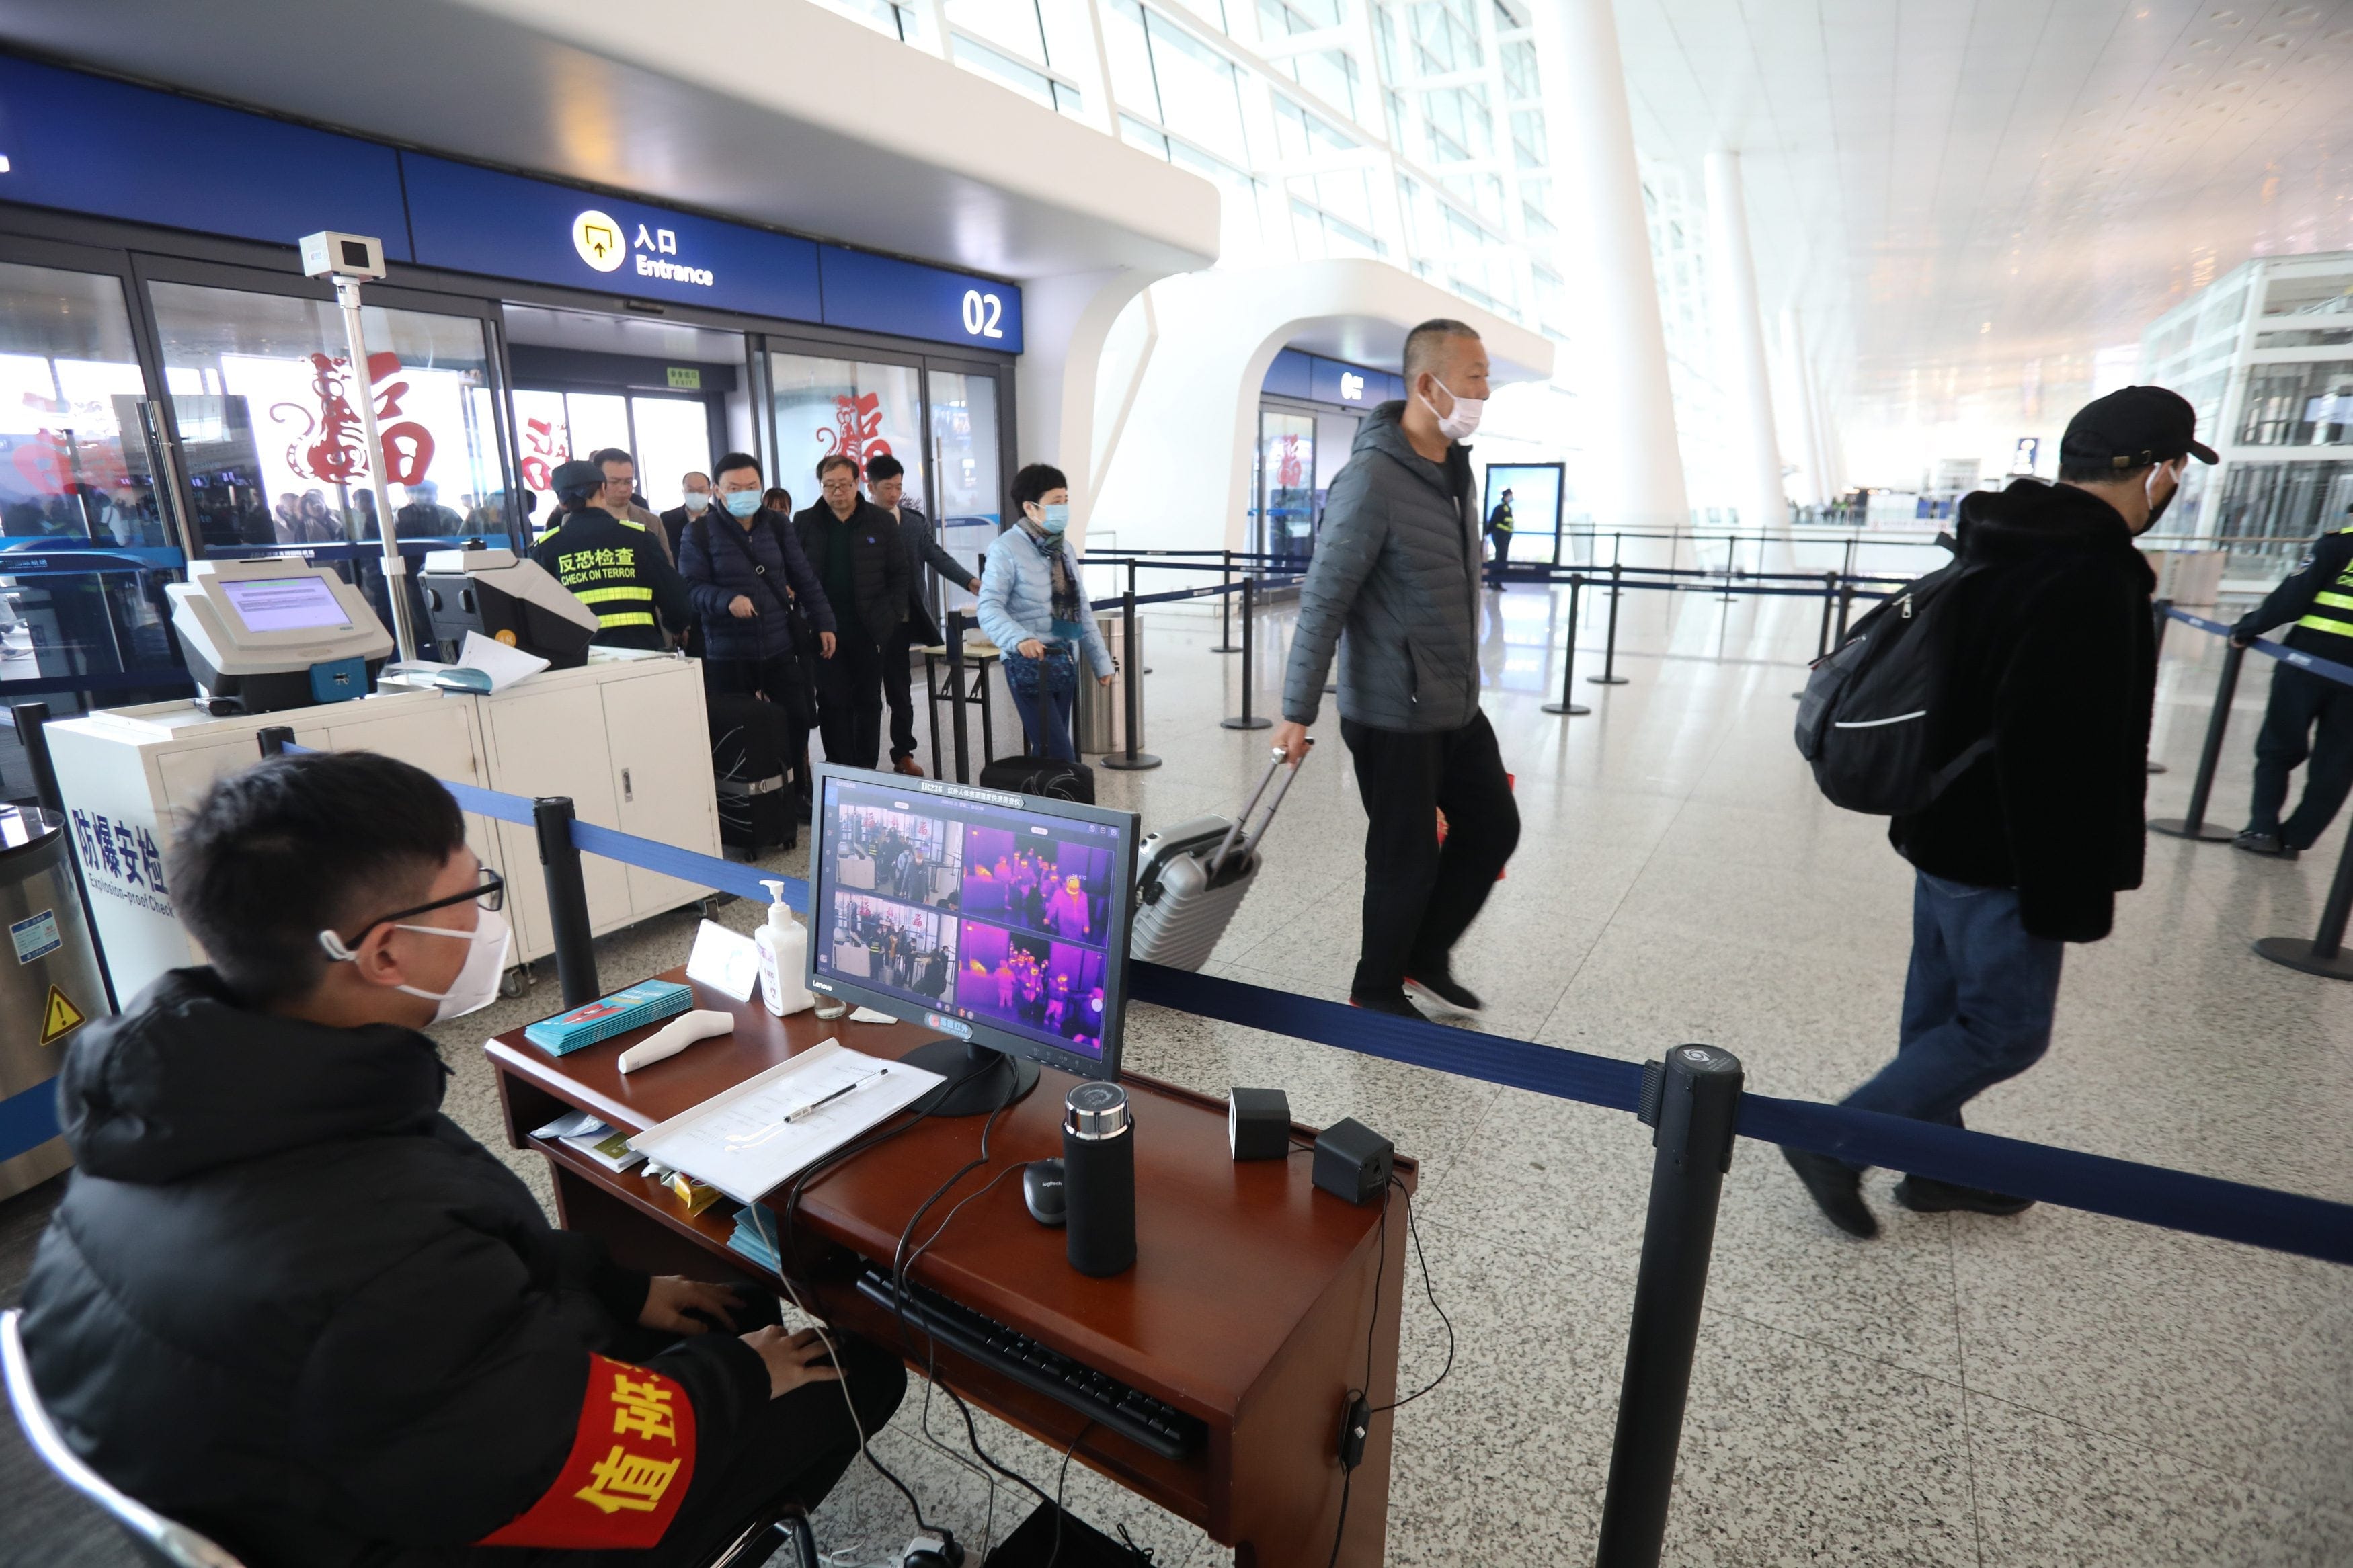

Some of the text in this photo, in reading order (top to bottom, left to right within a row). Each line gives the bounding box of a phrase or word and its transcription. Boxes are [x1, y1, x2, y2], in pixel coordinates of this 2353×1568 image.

[634, 224, 677, 255] 入口
[635, 254, 713, 286] Entrance
[963, 290, 1002, 339] 02
[558, 548, 635, 574] 反恐检查
[561, 567, 635, 587] CHECK ON TERROR
[921, 782, 943, 793] IR236
[72, 809, 169, 894] 防爆安检
[88, 872, 175, 918] Explosion-proof Check
[813, 979, 832, 991] Lenovo
